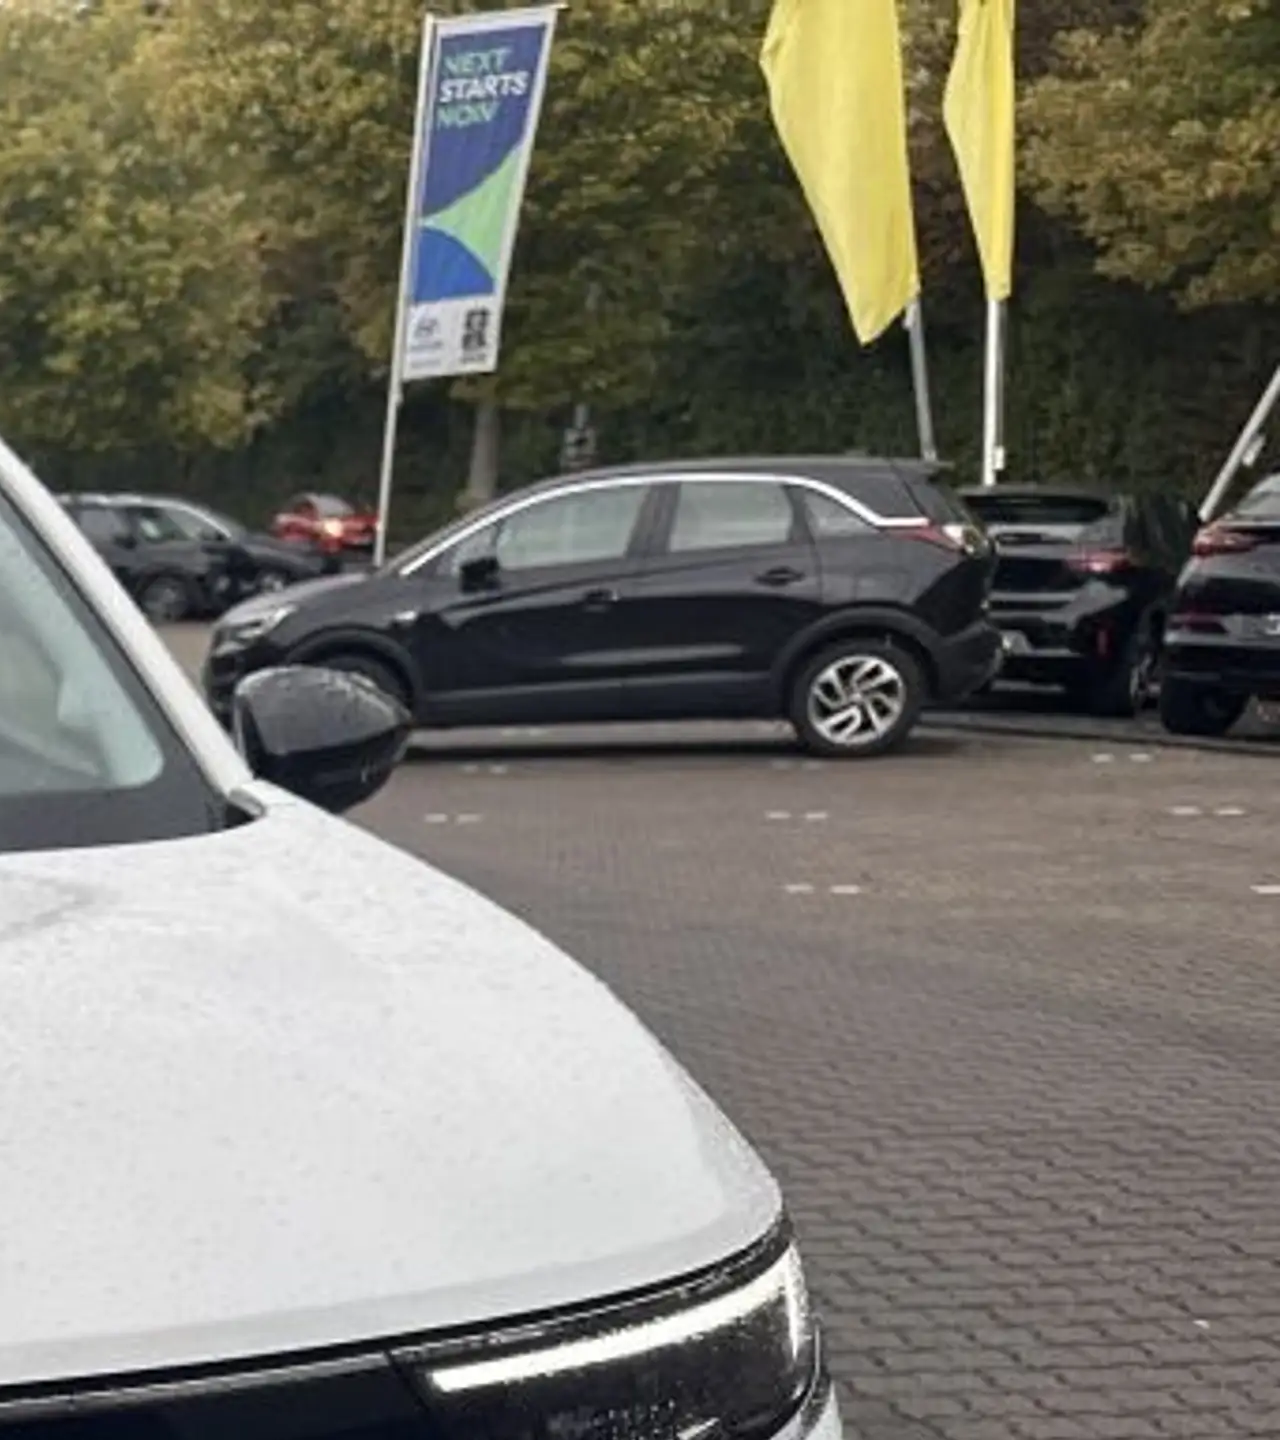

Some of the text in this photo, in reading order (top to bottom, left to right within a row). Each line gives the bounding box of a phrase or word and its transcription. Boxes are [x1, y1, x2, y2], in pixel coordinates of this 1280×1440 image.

[443, 47, 513, 77] NEXT
[439, 70, 530, 103] STARTS
[437, 100, 501, 127] NOW
